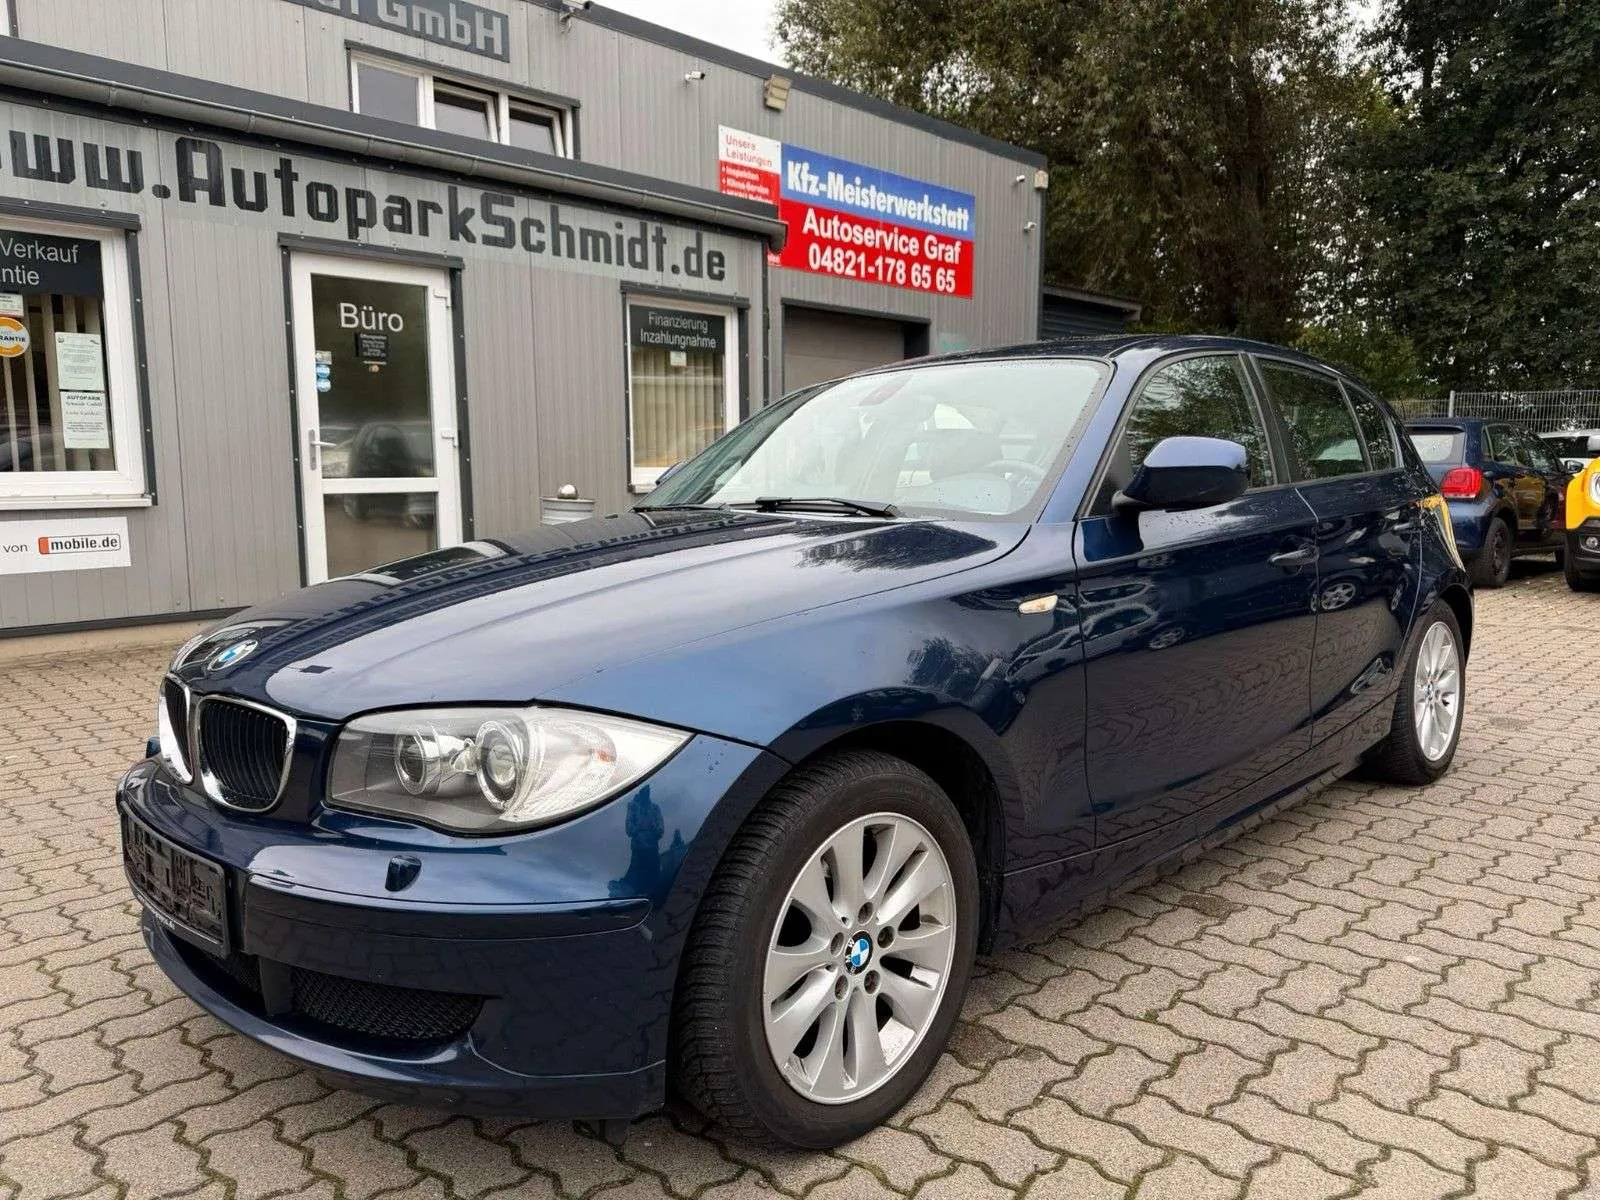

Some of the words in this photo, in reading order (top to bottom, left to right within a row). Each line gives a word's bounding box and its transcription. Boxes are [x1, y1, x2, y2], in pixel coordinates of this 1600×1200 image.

[377, 0, 505, 56] GmbH
[726, 134, 756, 151] Unsere
[726, 147, 773, 167] Leistungen
[0, 130, 726, 282] ww.AutoparkSchmidt.de
[787, 160, 970, 231] Kfz-Meisterwerkstatt
[802, 207, 920, 256] Autoservice
[924, 234, 962, 264] Graf
[0, 238, 80, 264] Verkauf
[0, 265, 40, 286] ntie
[808, 243, 907, 285] 04821-178
[911, 263, 932, 290] 65
[936, 267, 957, 293] 65
[340, 302, 404, 332] Büro
[648, 311, 709, 334] Finanzierung
[640, 328, 717, 349] Inzahlungnahme
[3, 544, 28, 553] von
[51, 536, 118, 551] mobile.de
